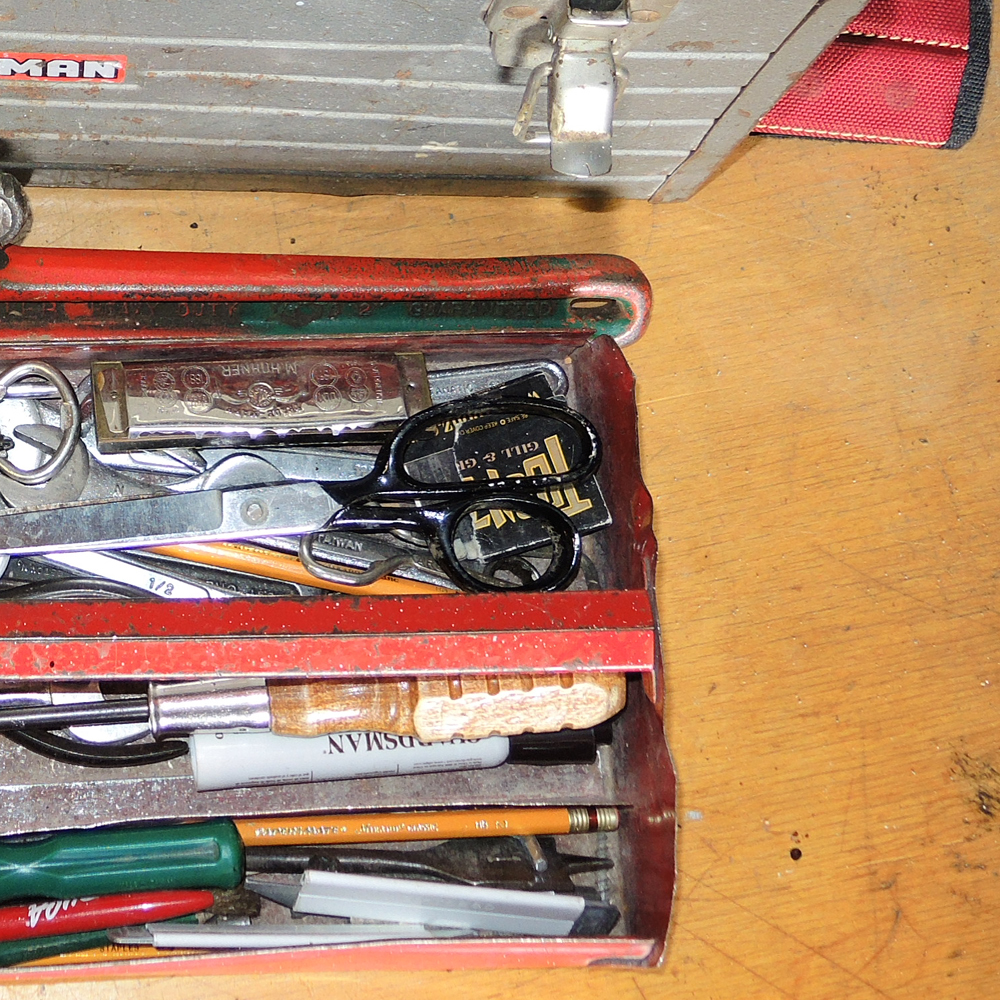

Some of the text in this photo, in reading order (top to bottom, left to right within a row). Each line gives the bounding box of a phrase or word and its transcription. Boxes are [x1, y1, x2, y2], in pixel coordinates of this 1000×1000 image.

[501, 441, 540, 458] GILL
[317, 533, 364, 552] TAIWAN
[148, 577, 175, 596] 1/2
